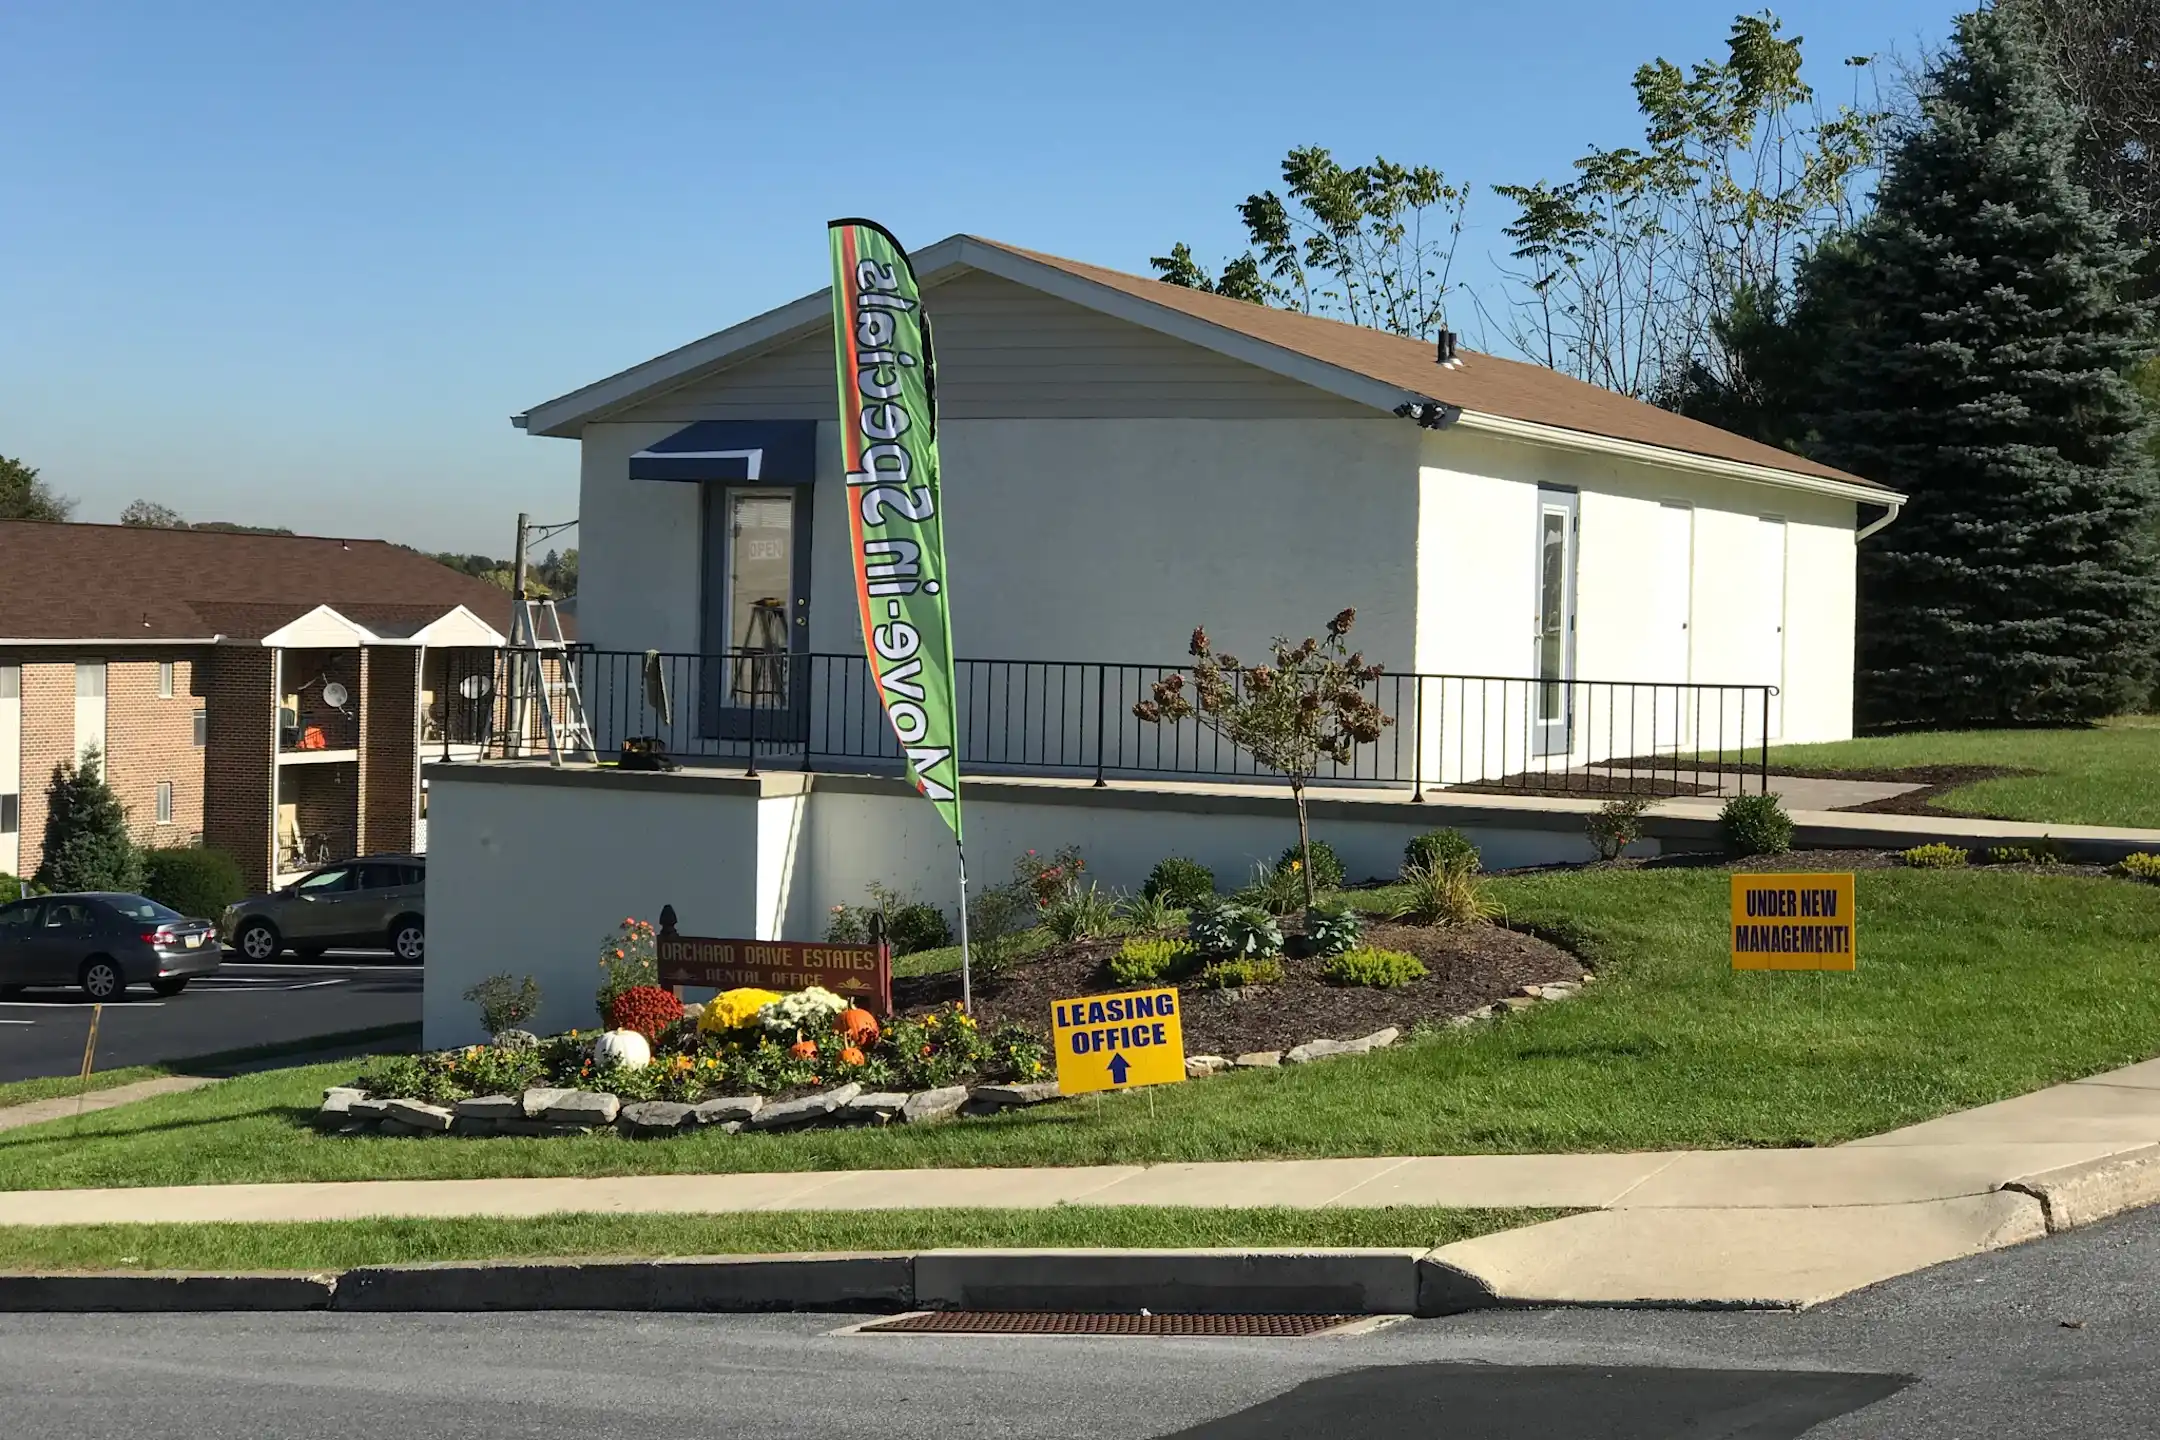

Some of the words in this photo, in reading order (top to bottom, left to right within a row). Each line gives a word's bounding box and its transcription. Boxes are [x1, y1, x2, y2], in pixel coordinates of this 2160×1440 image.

[750, 541, 784, 558] OPEN
[1746, 889, 1797, 917] UNDER
[1801, 889, 1837, 917] NEW
[1736, 925, 1850, 953] MANAGEMENT!
[661, 942, 735, 964] ORCHARD
[744, 945, 793, 966] DRIVE
[802, 948, 876, 971] ESTATES
[705, 968, 761, 984] RENTAL
[771, 970, 824, 986] OFFICE
[1056, 994, 1175, 1028] LEASING
[1072, 1023, 1167, 1054] OFFICE
